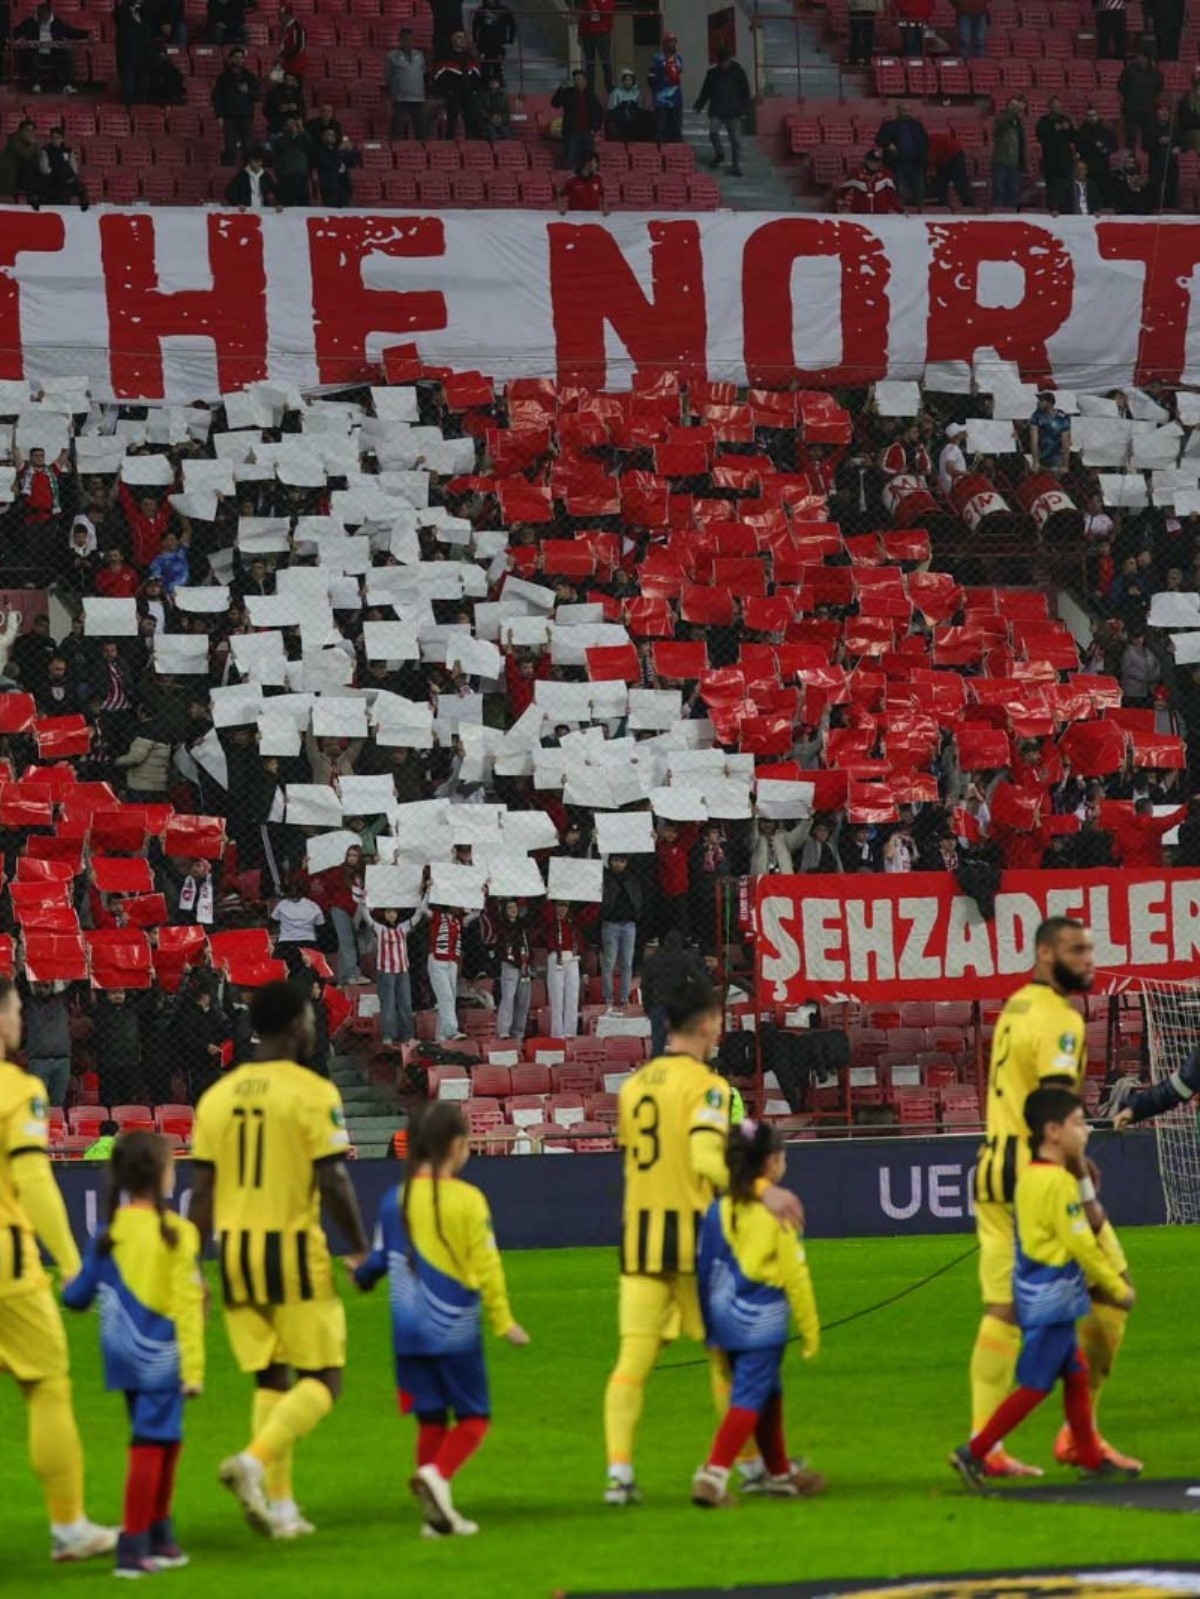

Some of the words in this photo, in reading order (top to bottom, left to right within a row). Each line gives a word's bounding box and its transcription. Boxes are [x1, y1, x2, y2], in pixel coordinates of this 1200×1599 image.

[231, 1106, 264, 1189] 11
[632, 1094, 660, 1171] 3
[879, 1164, 976, 1220] UE
